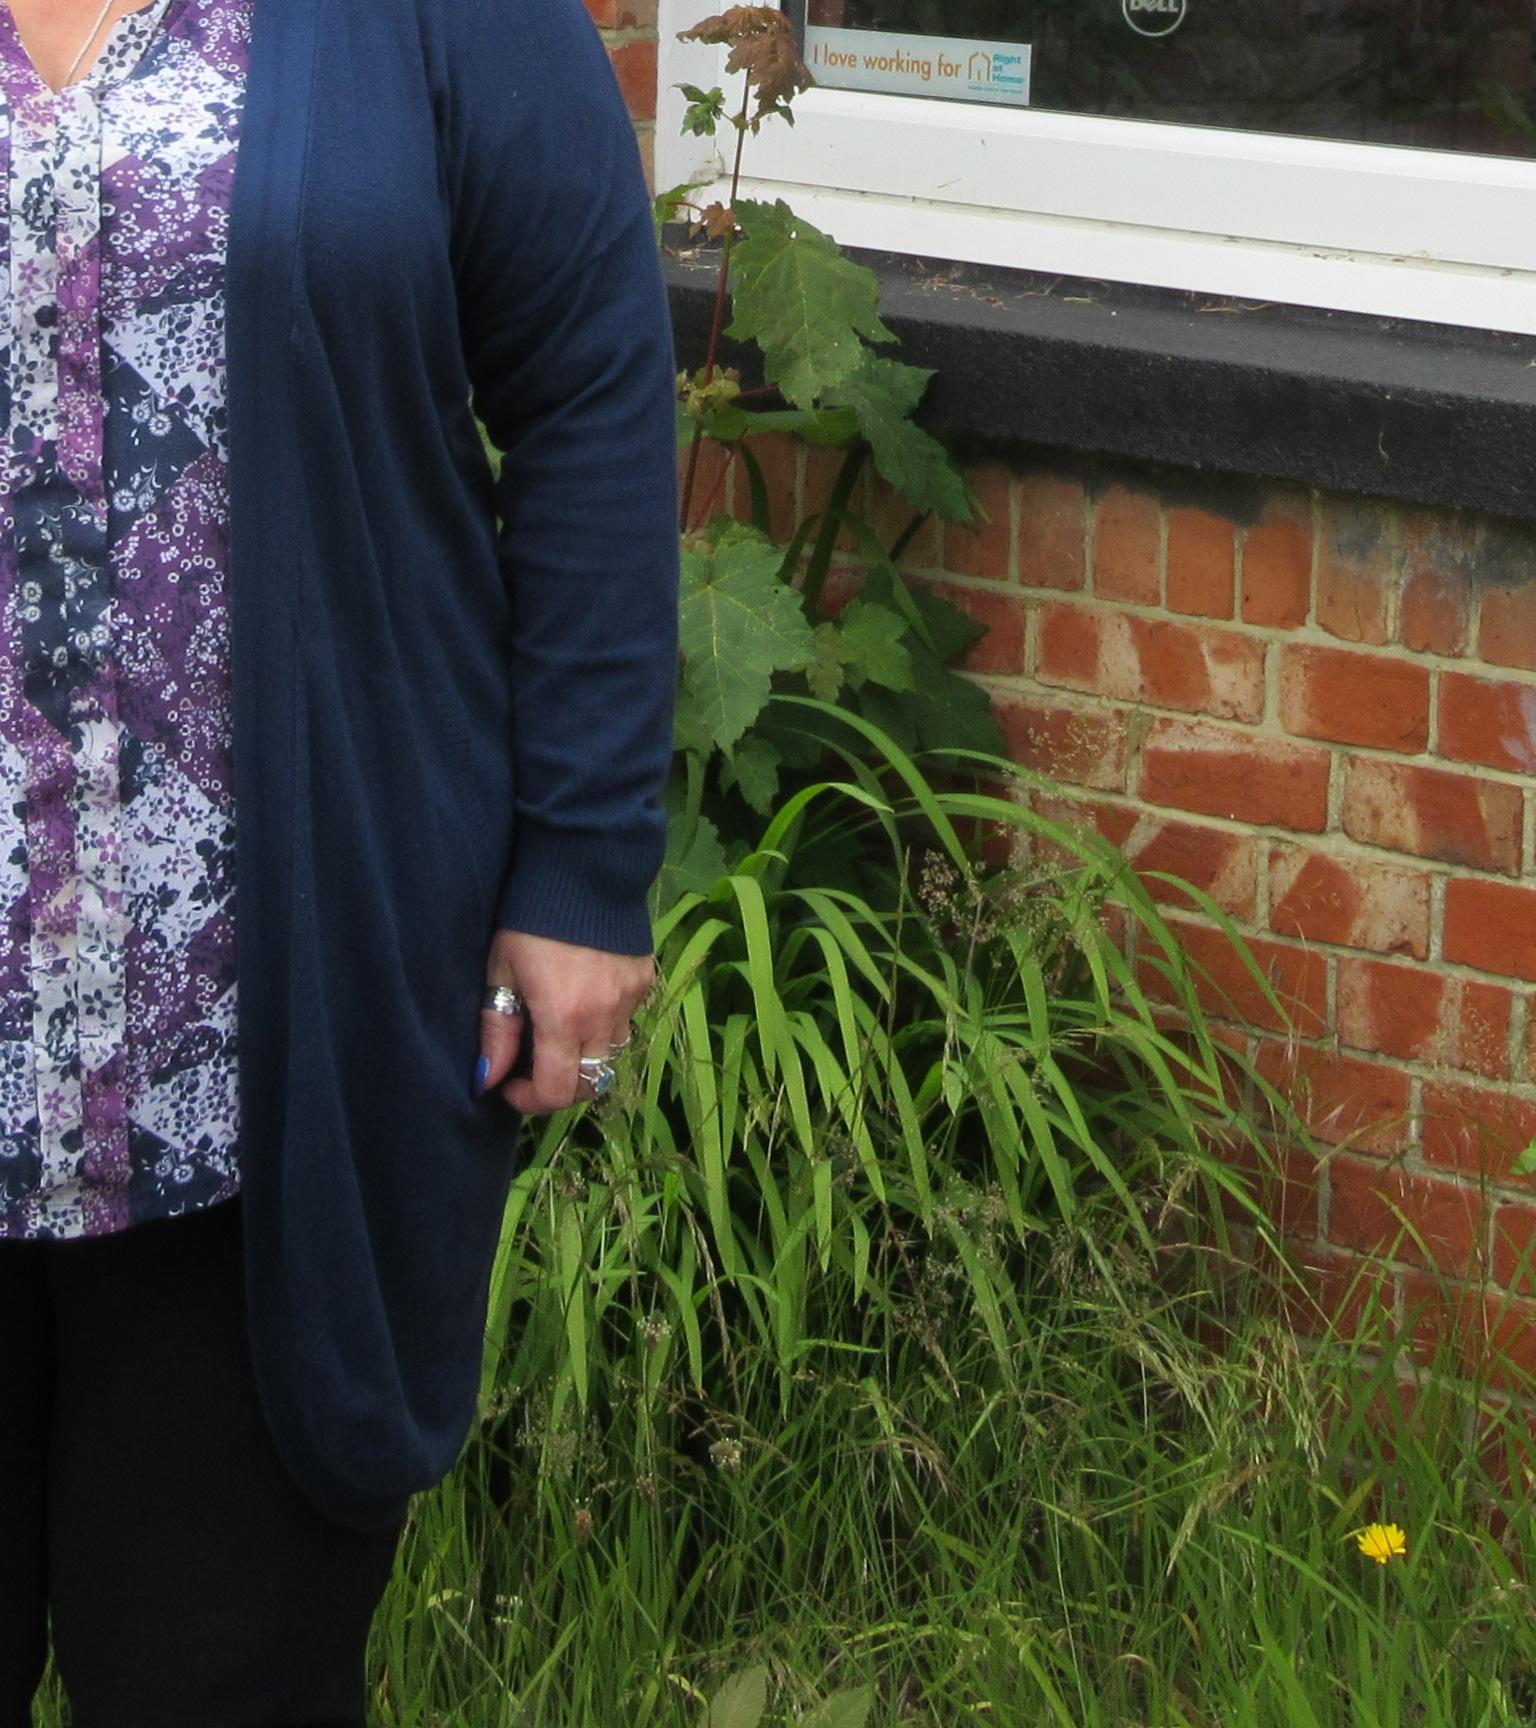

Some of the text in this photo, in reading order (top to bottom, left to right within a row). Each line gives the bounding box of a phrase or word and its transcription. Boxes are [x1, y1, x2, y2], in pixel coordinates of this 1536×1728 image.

[813, 41, 963, 82] I love working for
[993, 53, 1022, 65] Right
[992, 73, 1025, 85] Home
